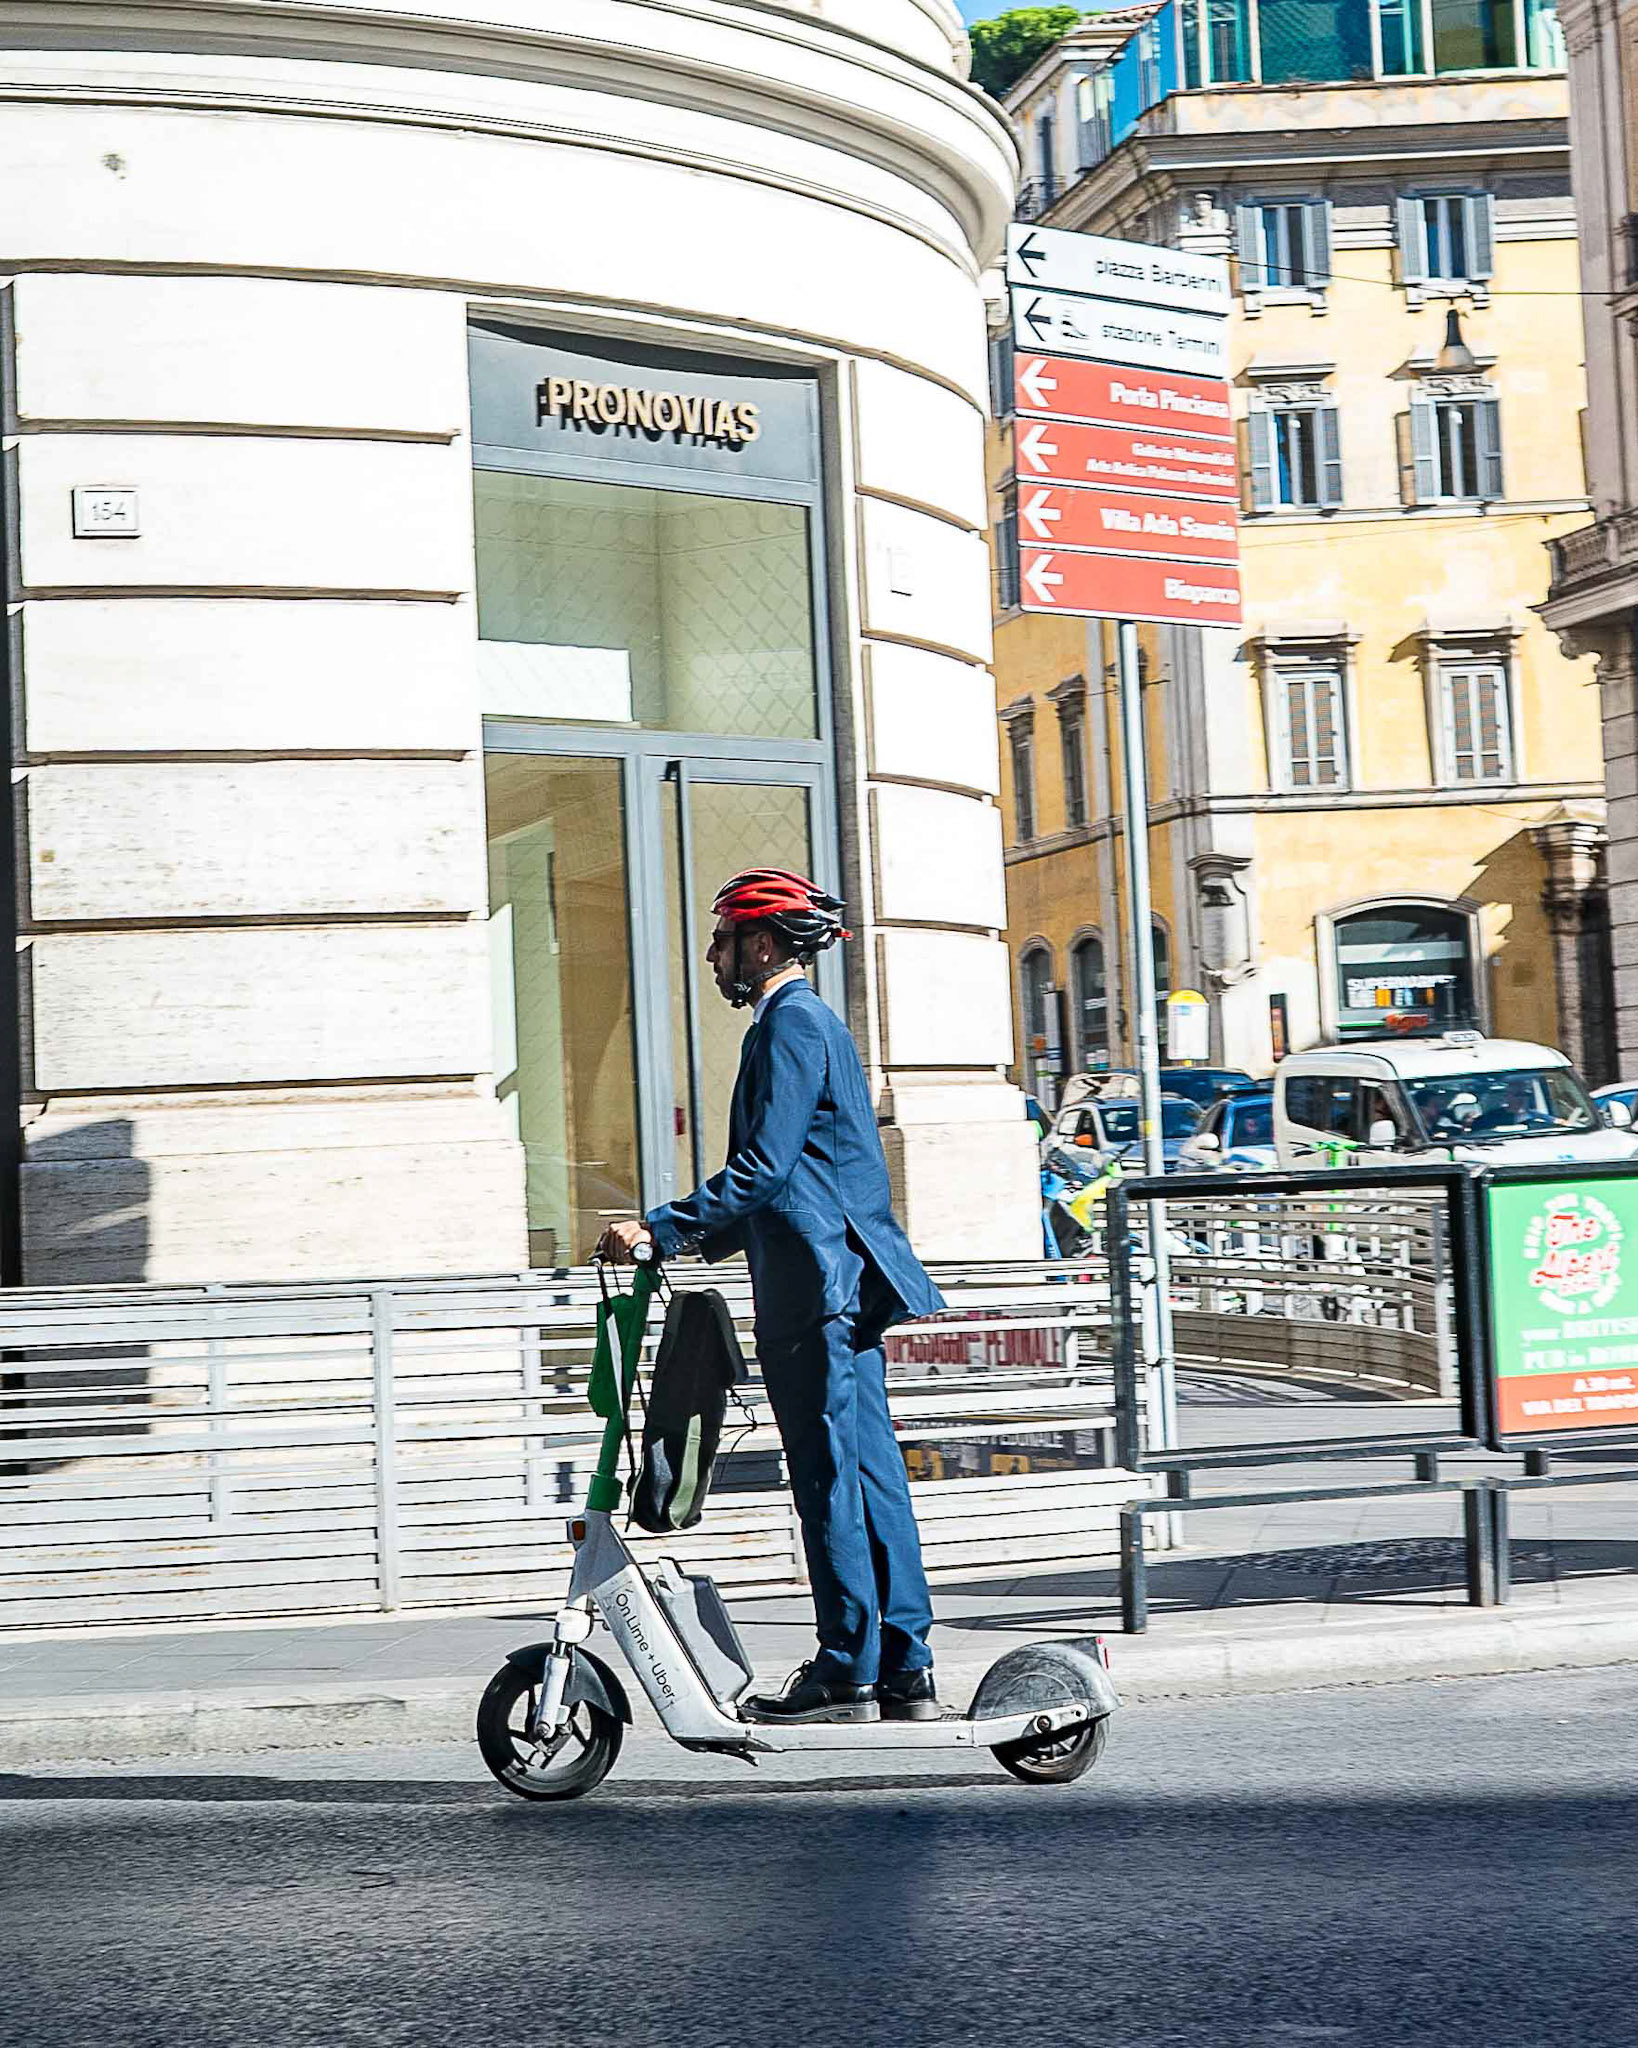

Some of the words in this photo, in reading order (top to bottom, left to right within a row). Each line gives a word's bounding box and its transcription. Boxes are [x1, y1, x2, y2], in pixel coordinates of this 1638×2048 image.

[1096, 258, 1145, 280] piazza
[1152, 264, 1222, 293] Barberini
[1102, 323, 1162, 346] stazione
[546, 376, 760, 443] PRONOVIAS
[1110, 382, 1158, 408] Porta
[1100, 508, 1142, 532] Villa
[1143, 512, 1179, 536] Ada
[615, 1592, 631, 1617] On
[626, 1615, 650, 1652] Lime
[651, 1662, 677, 1700] Uber
